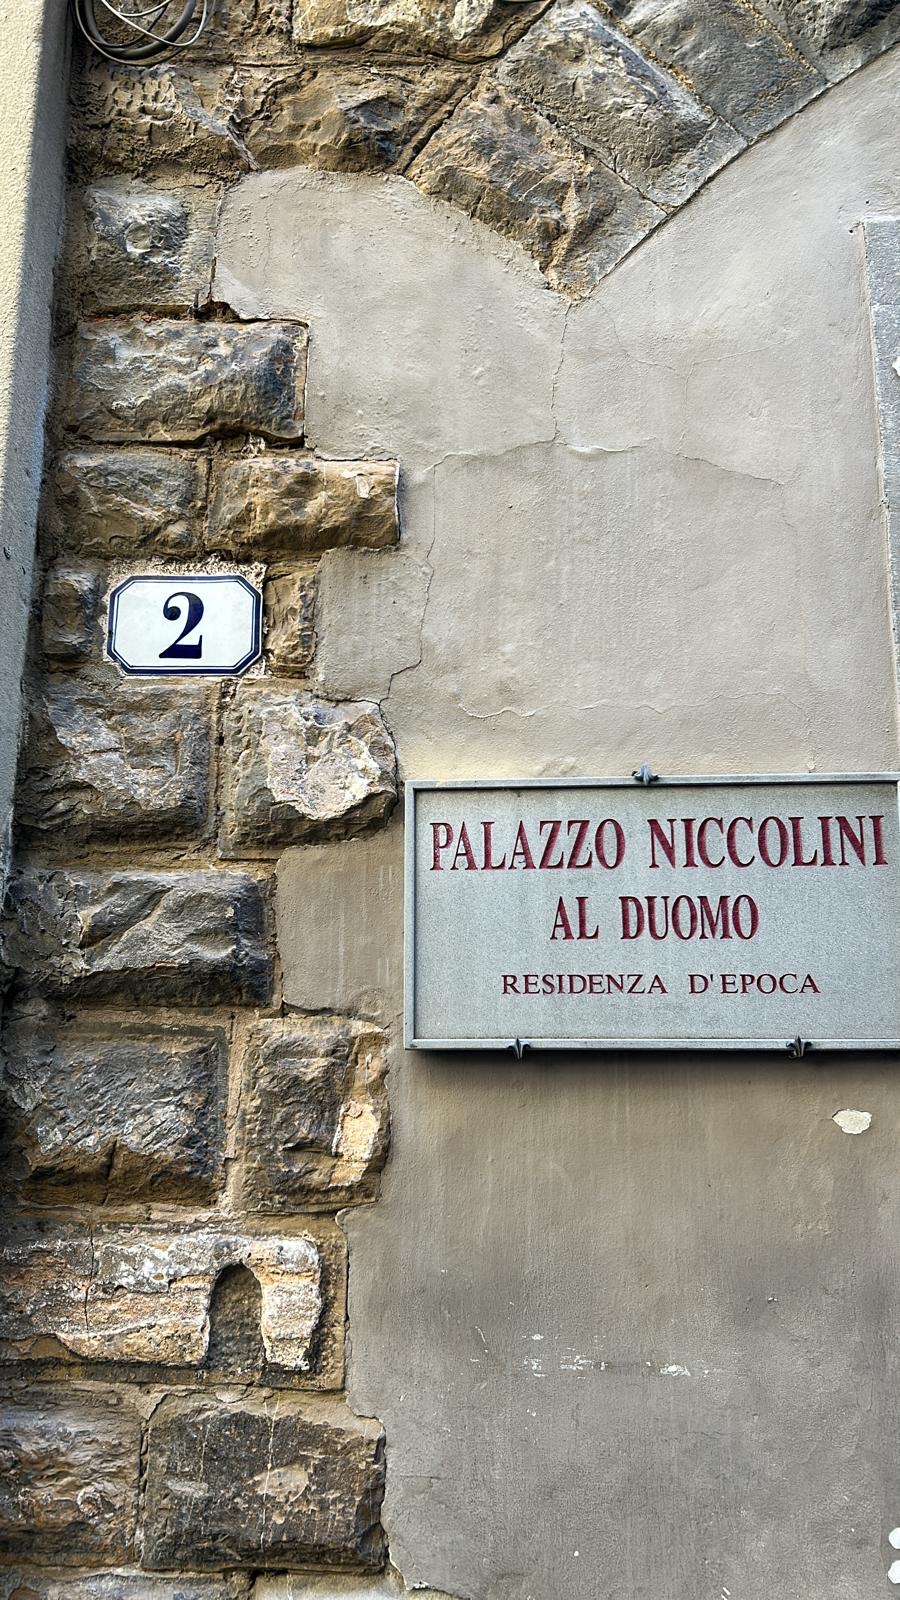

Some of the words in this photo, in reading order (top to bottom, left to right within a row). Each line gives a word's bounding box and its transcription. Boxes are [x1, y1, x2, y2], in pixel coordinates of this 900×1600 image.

[158, 591, 205, 659] 2
[429, 818, 627, 871] PALAZZO
[647, 815, 889, 869] NICCOLINI
[550, 896, 599, 941] AL
[618, 894, 760, 941] DUOMO
[501, 973, 668, 996] RESIDENZA
[688, 973, 822, 995] D'EPOCA
